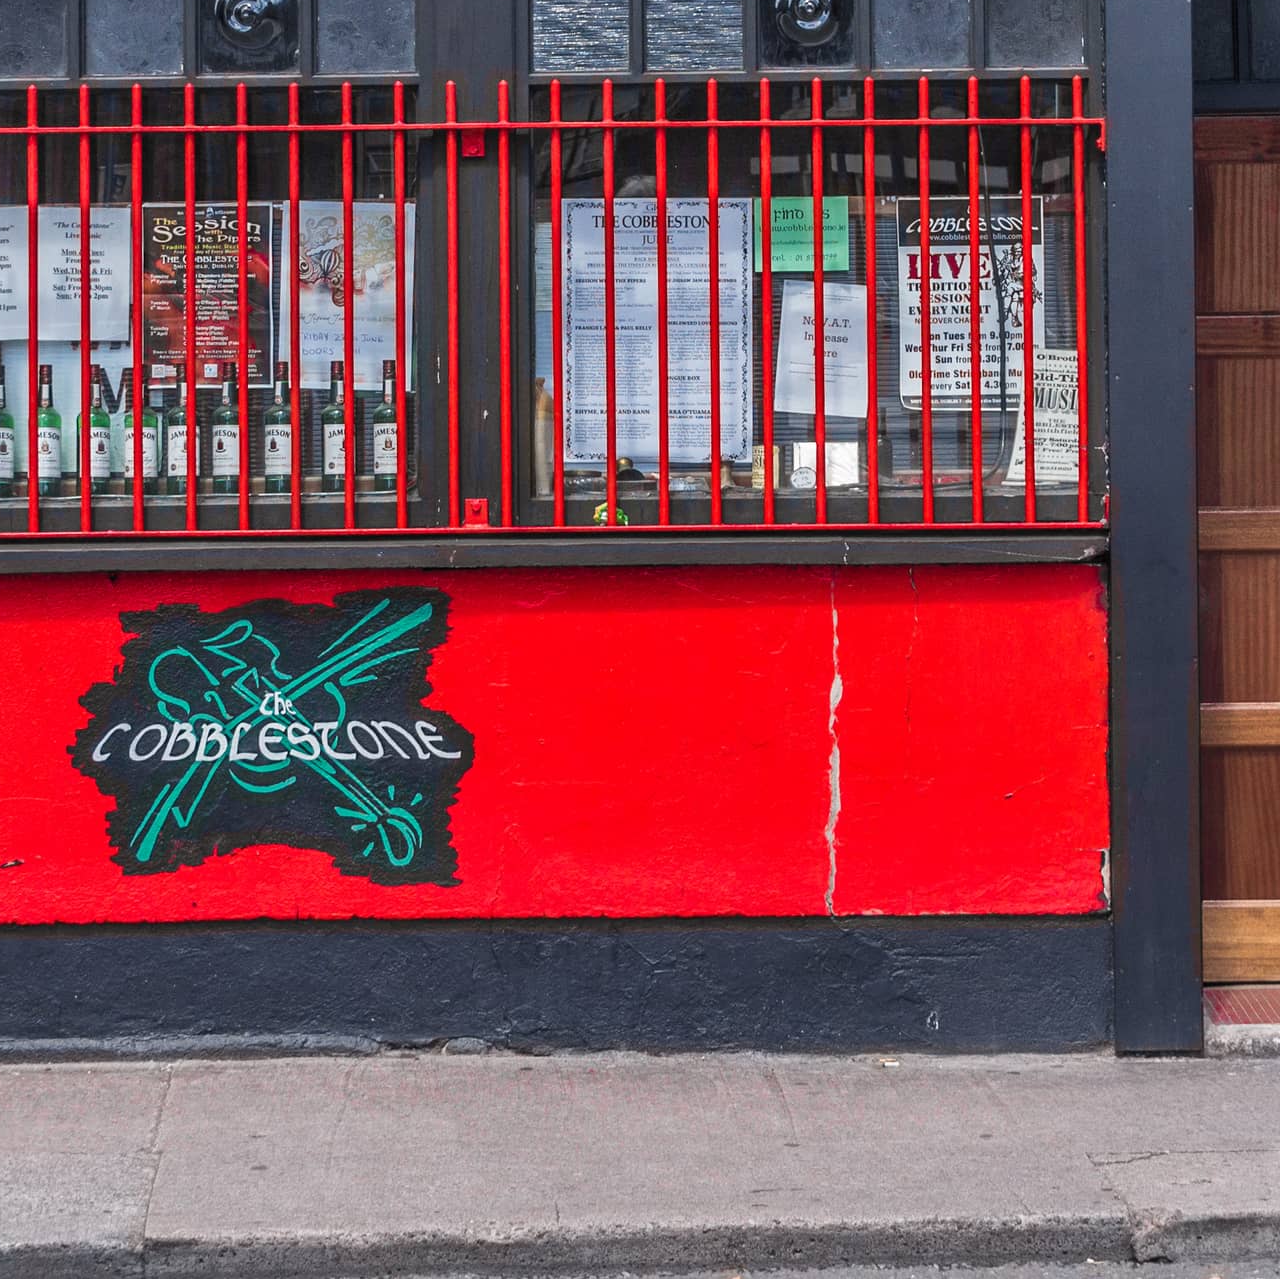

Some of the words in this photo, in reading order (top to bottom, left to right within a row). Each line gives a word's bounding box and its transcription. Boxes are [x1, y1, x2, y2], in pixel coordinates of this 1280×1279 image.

[622, 215, 720, 229] COBBESTON
[217, 235, 261, 244] Piprs
[641, 234, 674, 245] JUE
[160, 255, 180, 265] THE
[907, 253, 991, 280] LIVE
[907, 282, 991, 292] TRDITIOAL
[908, 306, 946, 315] EVRY
[804, 331, 849, 344] Inease
[930, 332, 940, 340] on
[943, 331, 965, 340] Tues
[968, 331, 987, 340] fm
[812, 347, 838, 358] ere
[951, 343, 963, 352] Fri
[1007, 343, 1040, 351] 7.00m
[935, 355, 952, 364] Sun
[1048, 354, 1078, 362] Broth
[1034, 373, 1078, 383] Old-Ti
[931, 382, 952, 391] every
[1034, 387, 1077, 410] MUSI
[38, 431, 61, 441] MESON
[92, 720, 462, 762] COBBLESTONE
